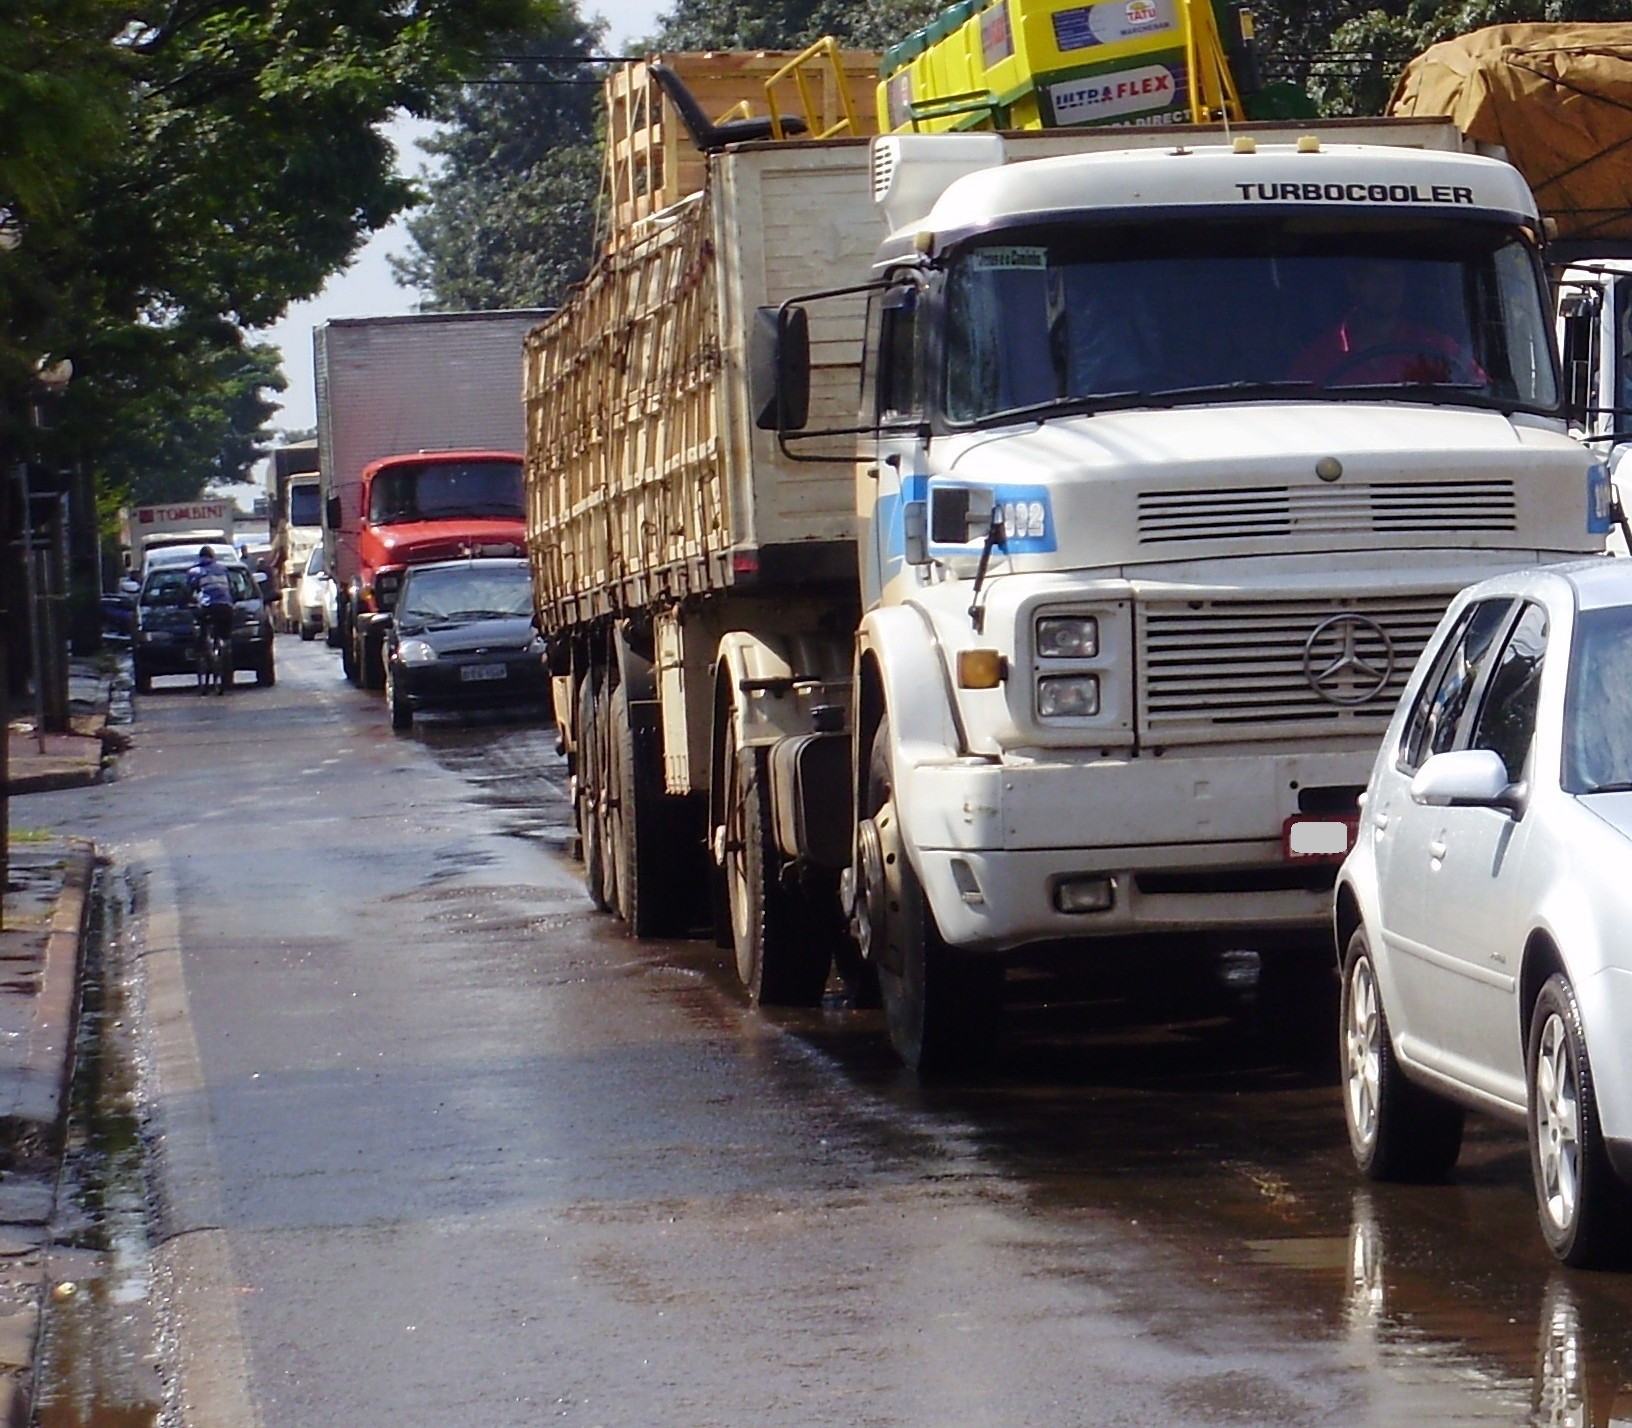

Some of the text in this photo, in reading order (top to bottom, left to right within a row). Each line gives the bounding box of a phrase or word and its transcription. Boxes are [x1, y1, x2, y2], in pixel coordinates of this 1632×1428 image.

[1126, 8, 1156, 20] TATU
[1117, 75, 1169, 98] FLEX
[1136, 109, 1192, 127] DIRECT
[1235, 183, 1474, 204] TURBOCOOLER
